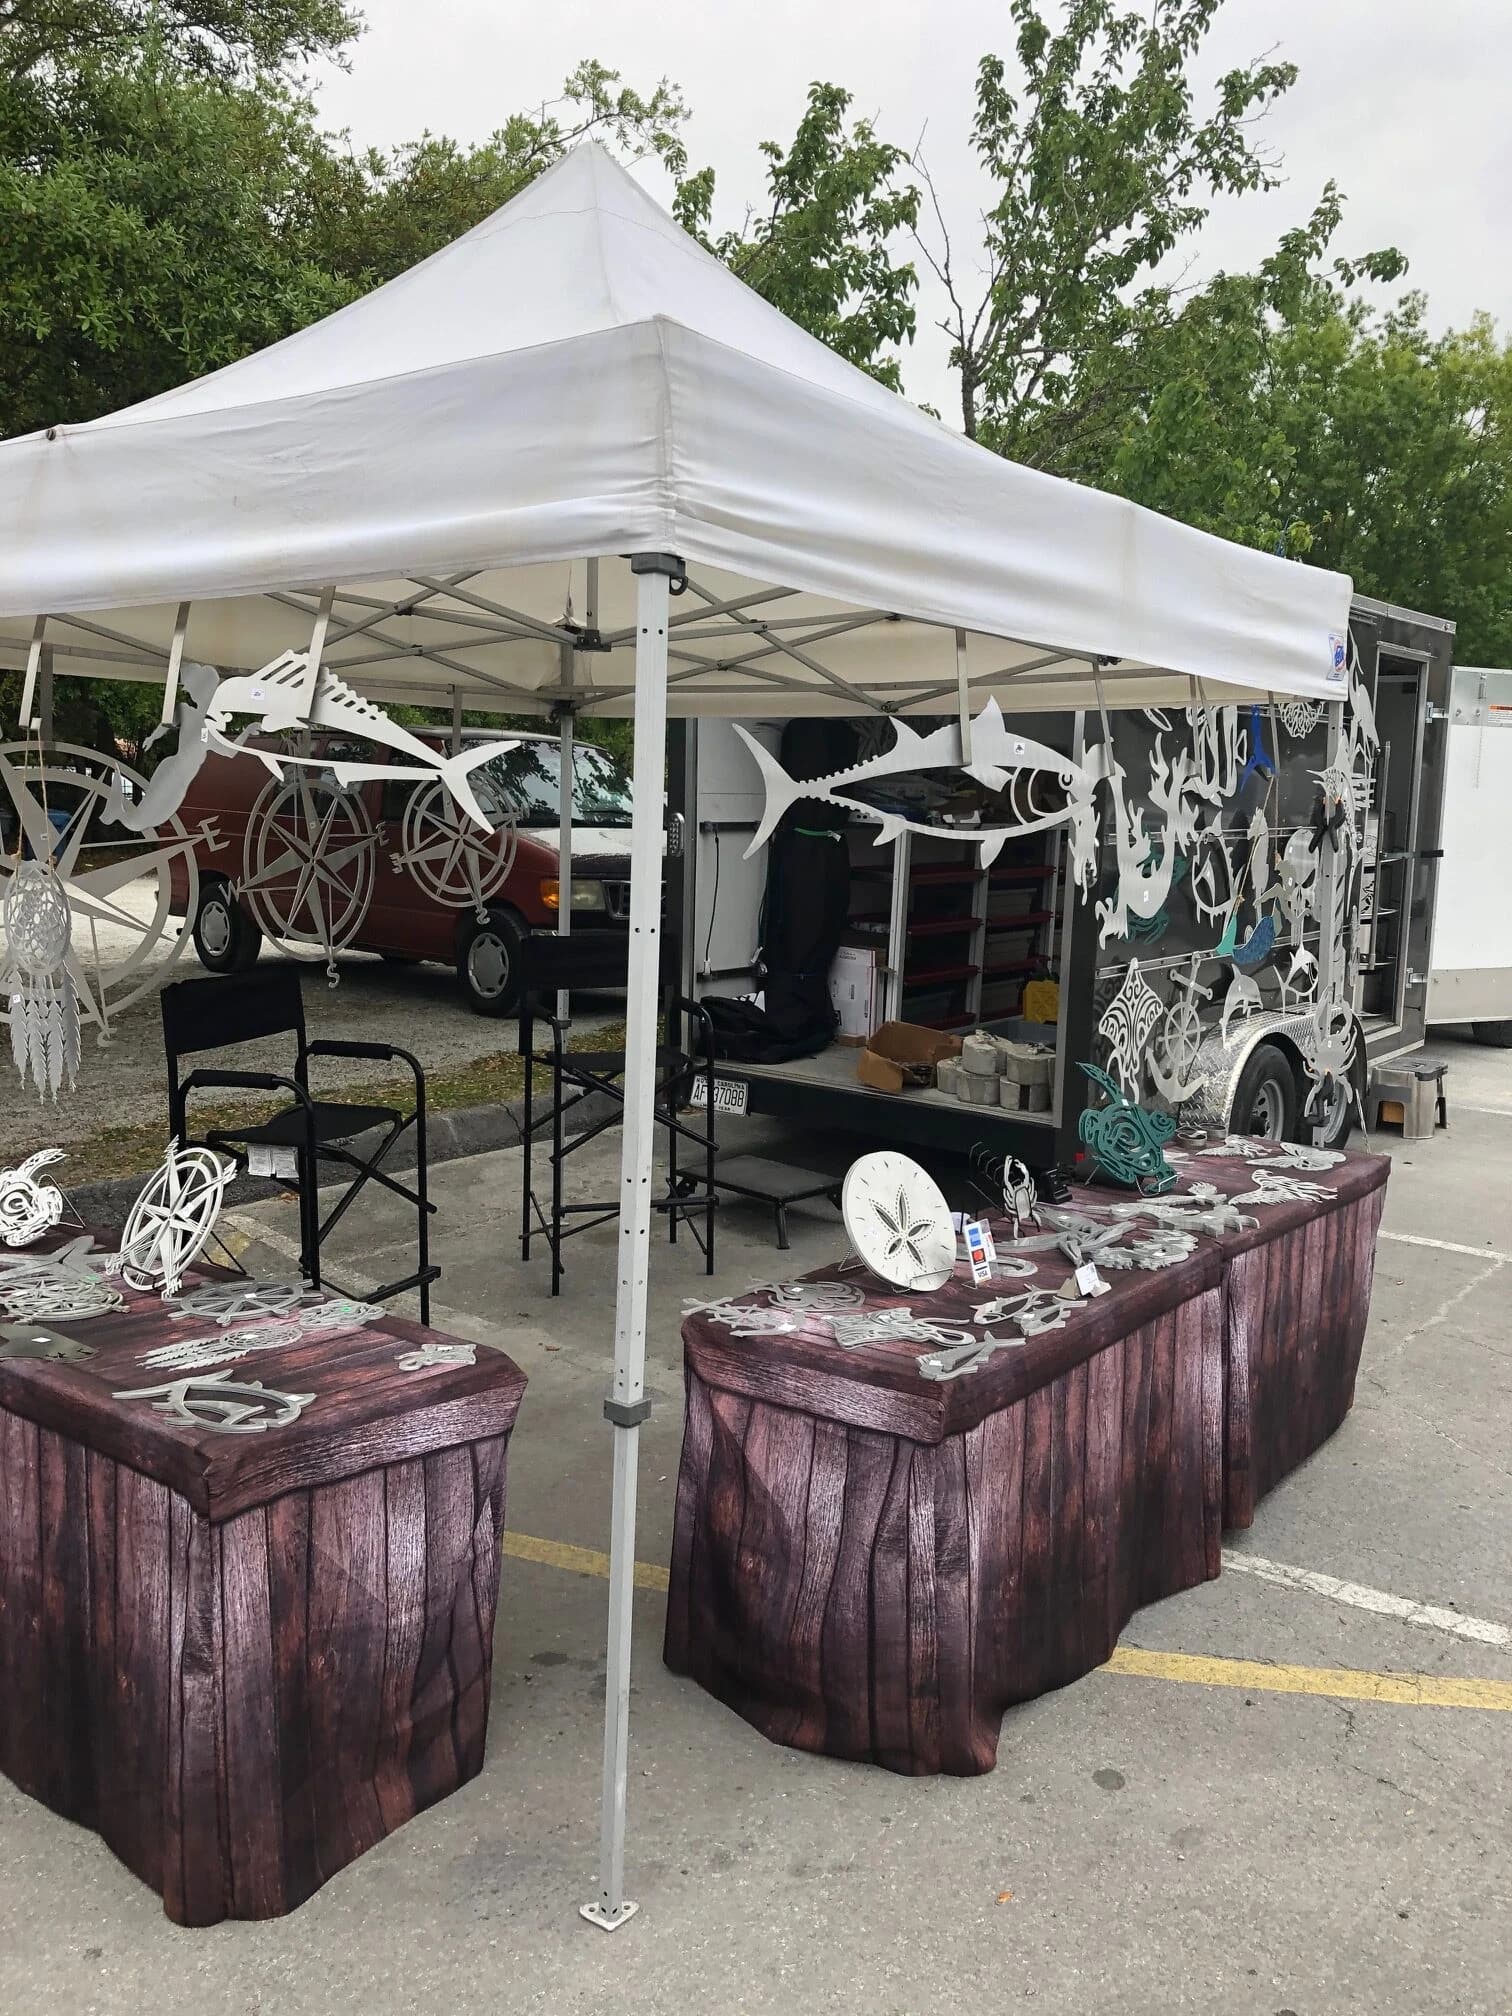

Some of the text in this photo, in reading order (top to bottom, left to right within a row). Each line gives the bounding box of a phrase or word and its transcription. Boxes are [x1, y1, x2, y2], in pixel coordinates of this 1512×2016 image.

[196, 815, 230, 852] E
[376, 821, 389, 846] E
[218, 876, 241, 907] W
[326, 962, 340, 989] S
[977, 1270, 988, 1278] VISA
